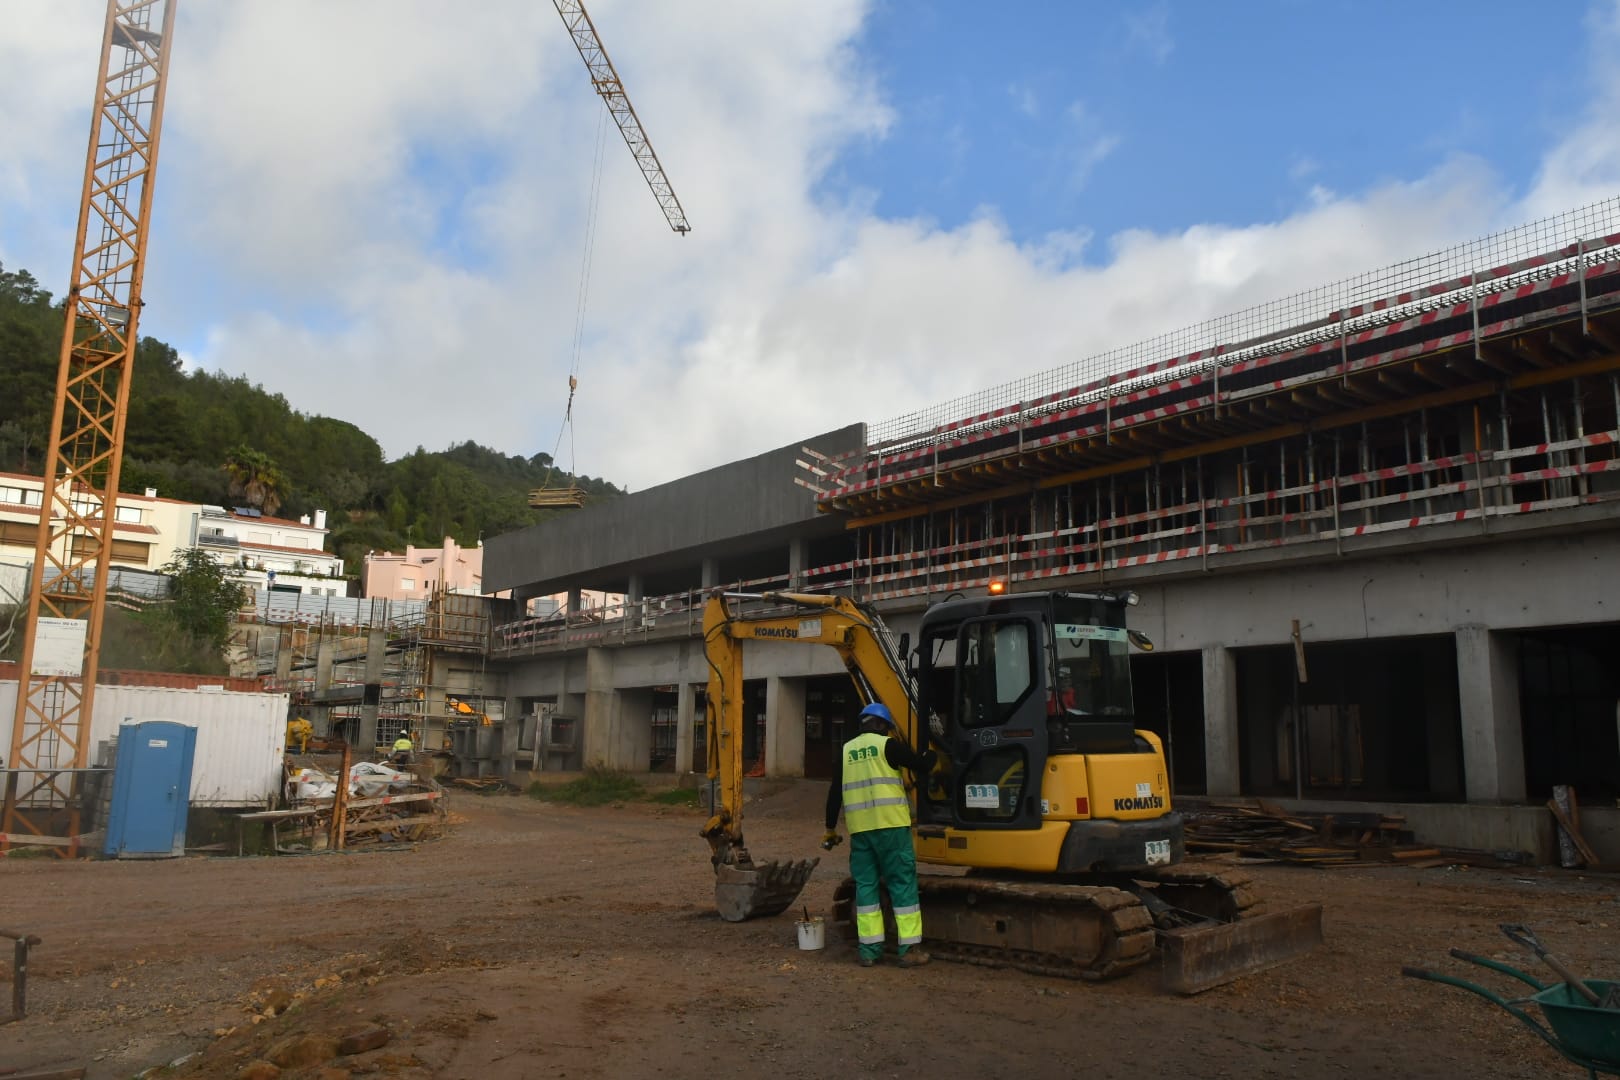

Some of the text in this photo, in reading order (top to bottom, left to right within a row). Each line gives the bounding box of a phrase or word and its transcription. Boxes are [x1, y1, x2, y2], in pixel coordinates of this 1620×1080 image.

[754, 626, 798, 638] KOMATSU
[967, 786, 998, 797] ABB
[1113, 793, 1163, 811] KOMATSU
